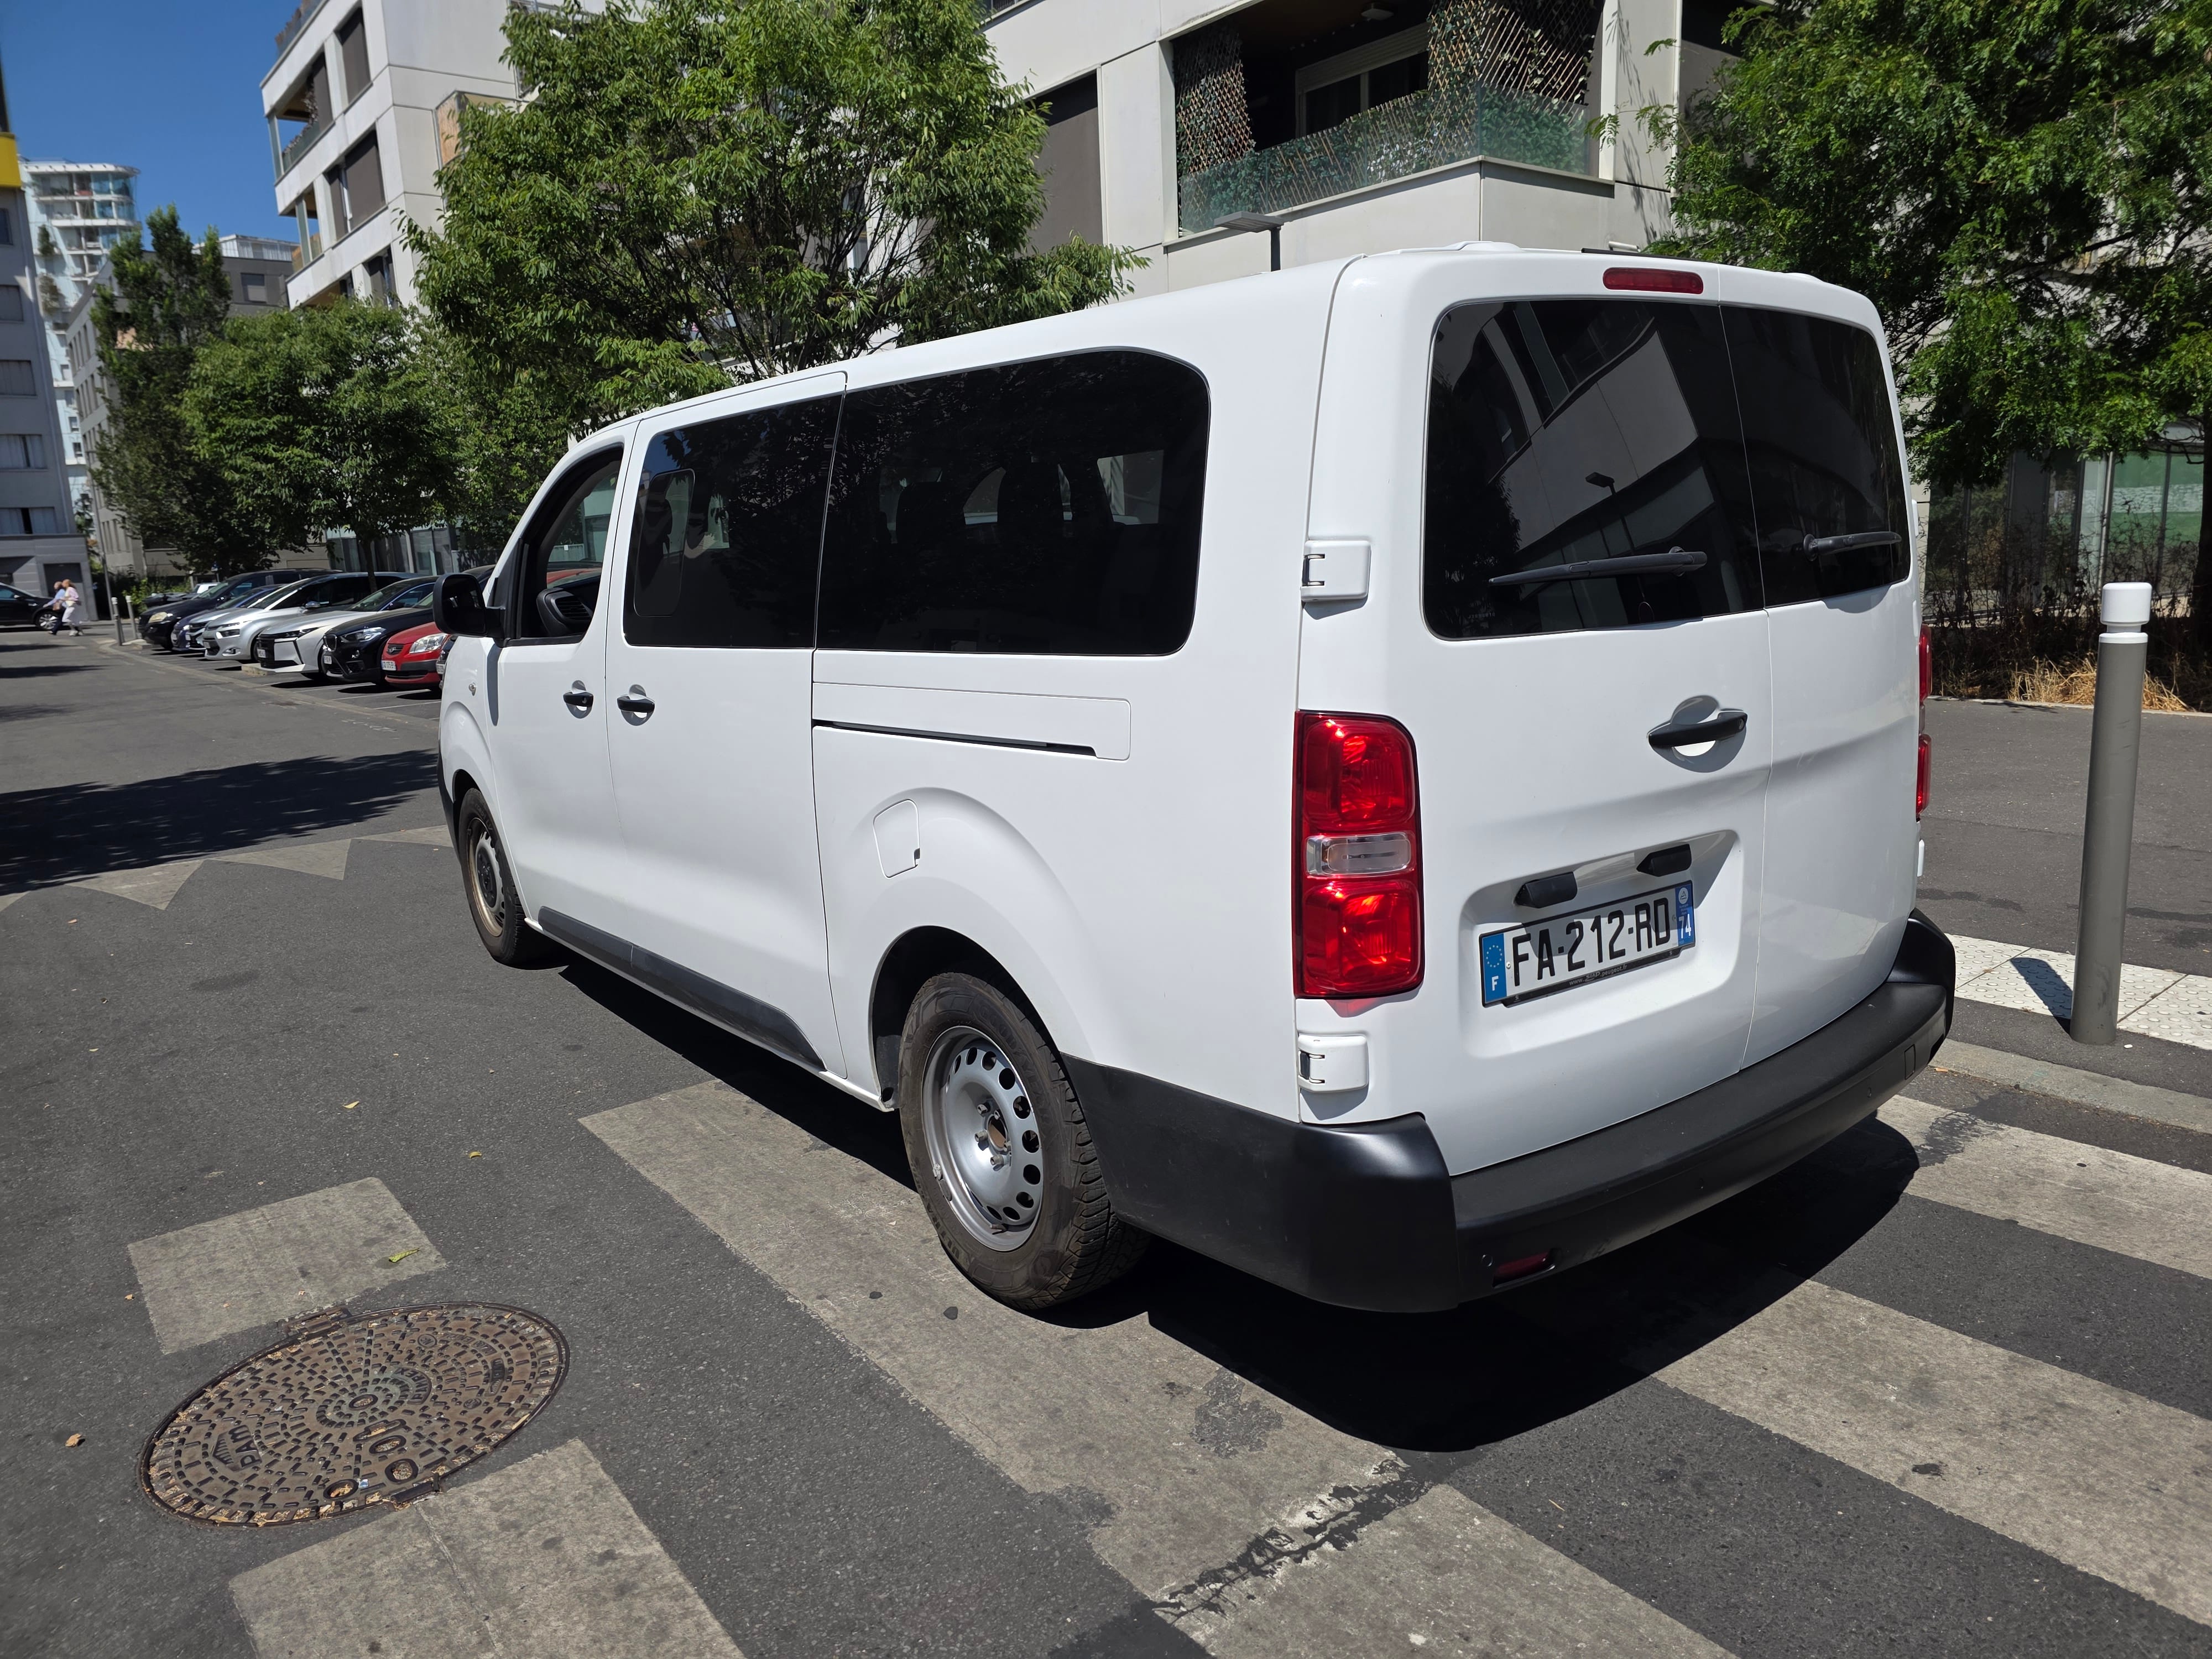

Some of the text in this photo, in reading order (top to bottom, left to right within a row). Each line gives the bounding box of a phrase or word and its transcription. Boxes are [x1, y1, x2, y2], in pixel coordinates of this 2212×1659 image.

[1512, 897, 1670, 987] FA-212-RD
[1678, 914, 1692, 939] 74
[1491, 975, 1499, 991] F
[228, 1424, 263, 1468] PAM
